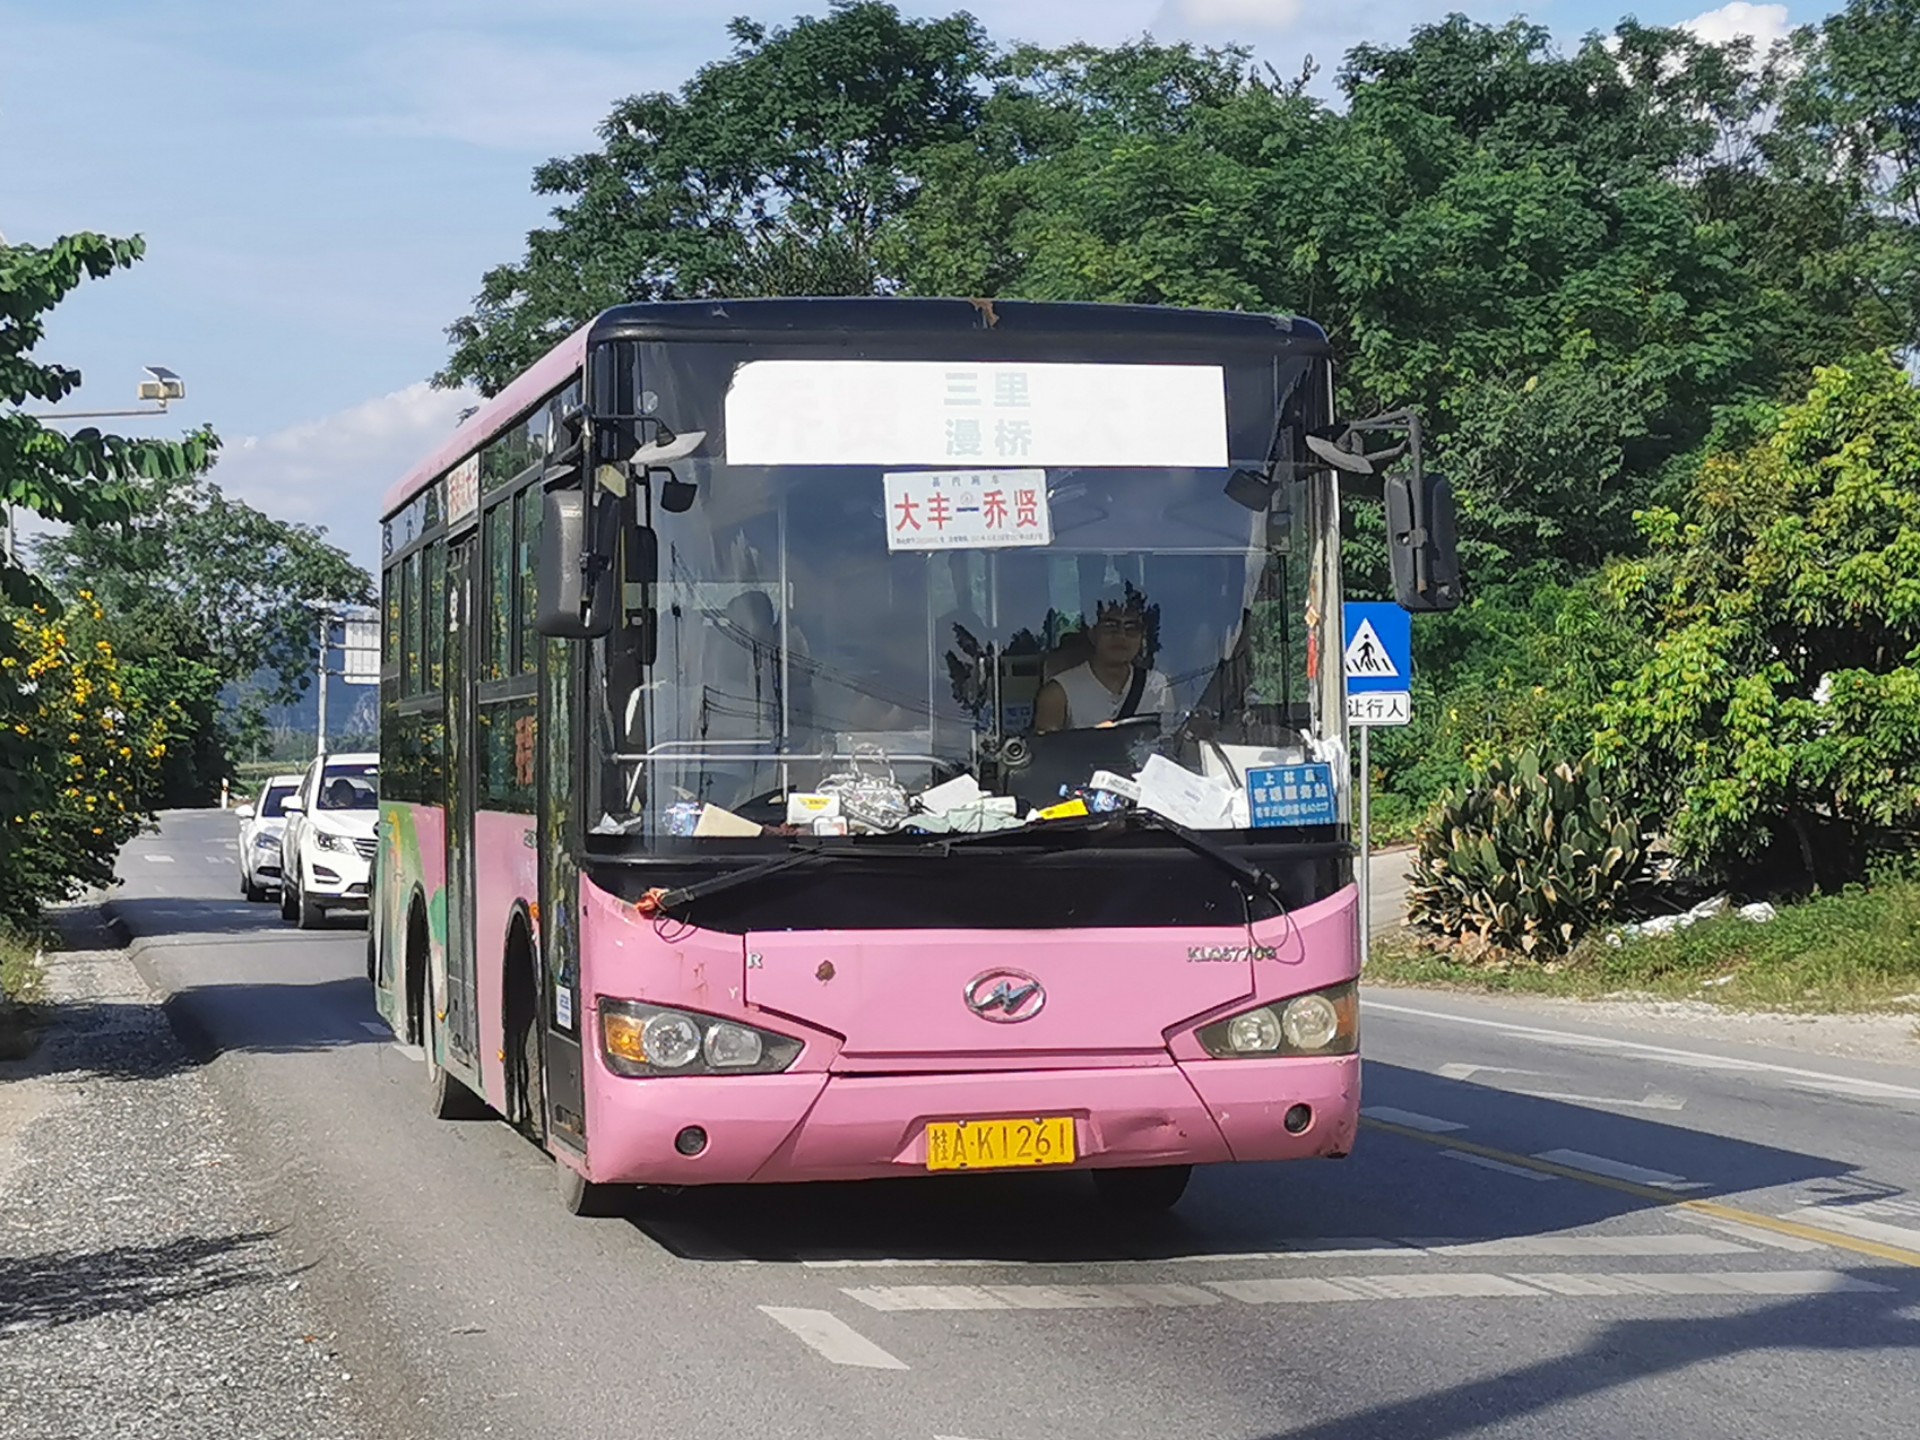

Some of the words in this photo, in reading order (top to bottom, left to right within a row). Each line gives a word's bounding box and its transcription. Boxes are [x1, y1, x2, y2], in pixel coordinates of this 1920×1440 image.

[943, 371, 1031, 408] 三里
[944, 418, 1033, 457] 漫桥
[1348, 698, 1404, 718] 让行人
